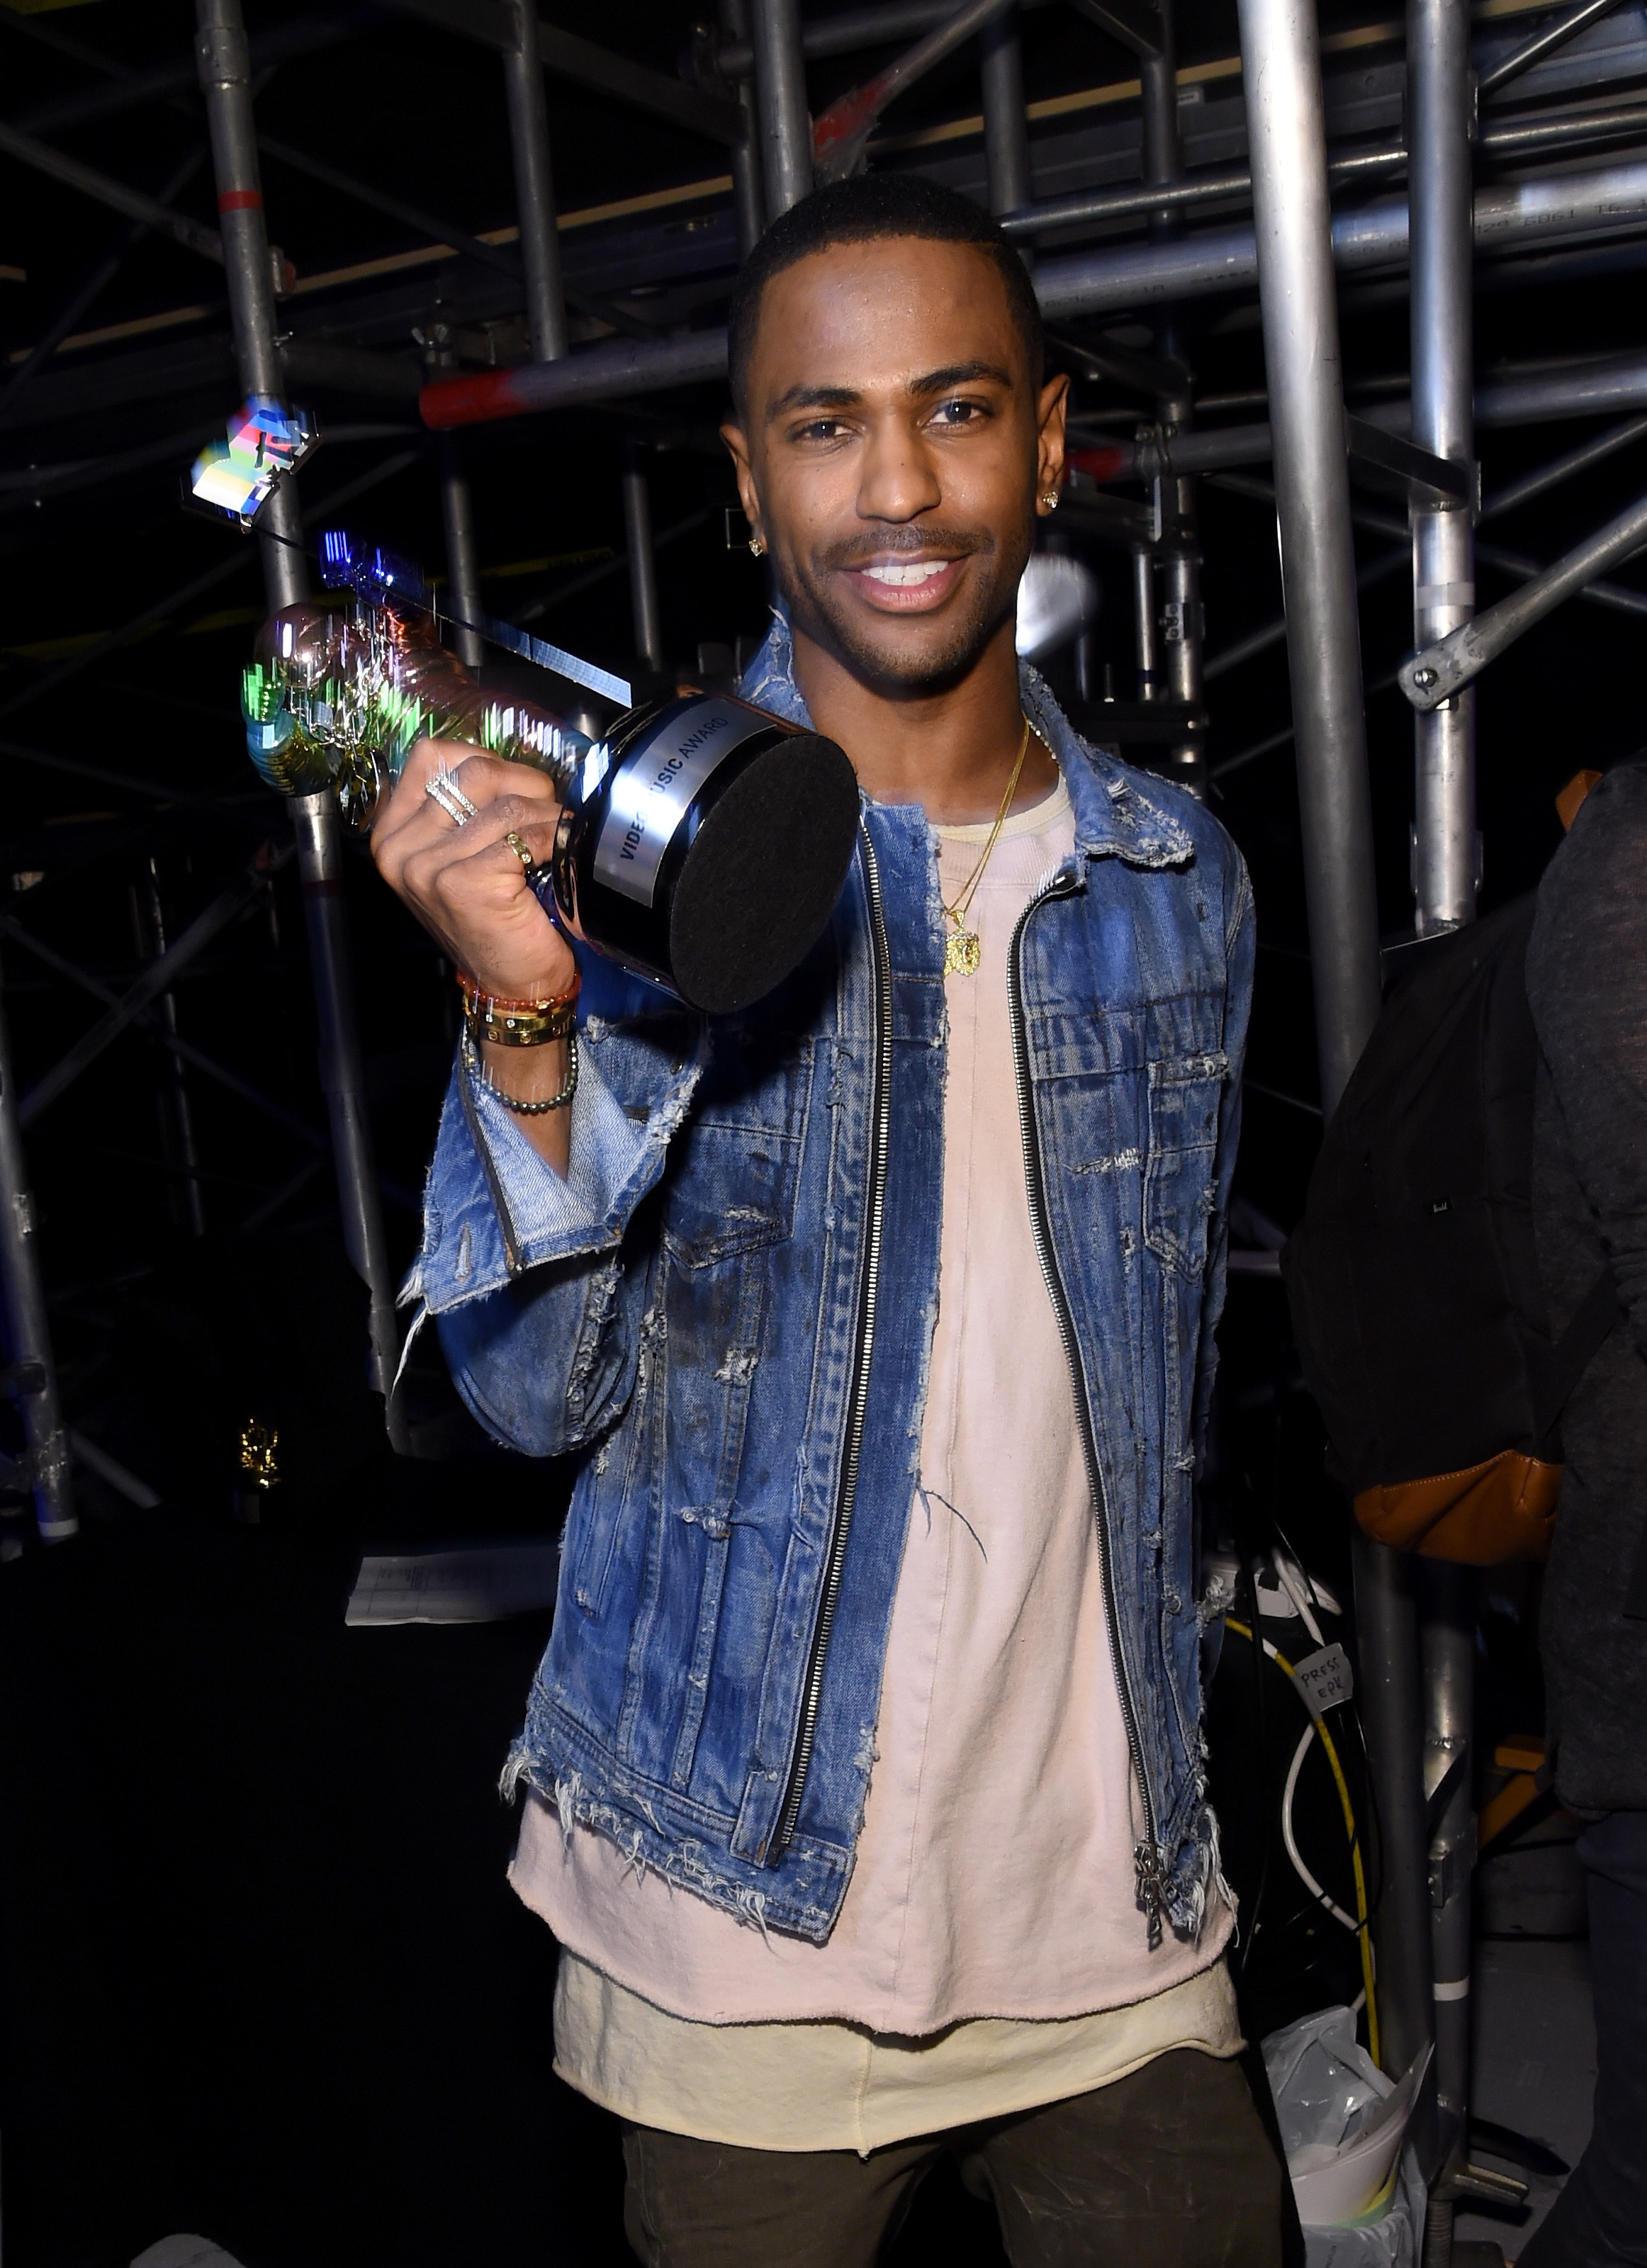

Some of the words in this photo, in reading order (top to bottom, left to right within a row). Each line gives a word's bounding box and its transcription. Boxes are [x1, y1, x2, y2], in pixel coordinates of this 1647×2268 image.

[649, 758, 683, 795] USIC
[679, 717, 728, 759] AWARD
[1302, 1657, 1339, 1687] PRESS
